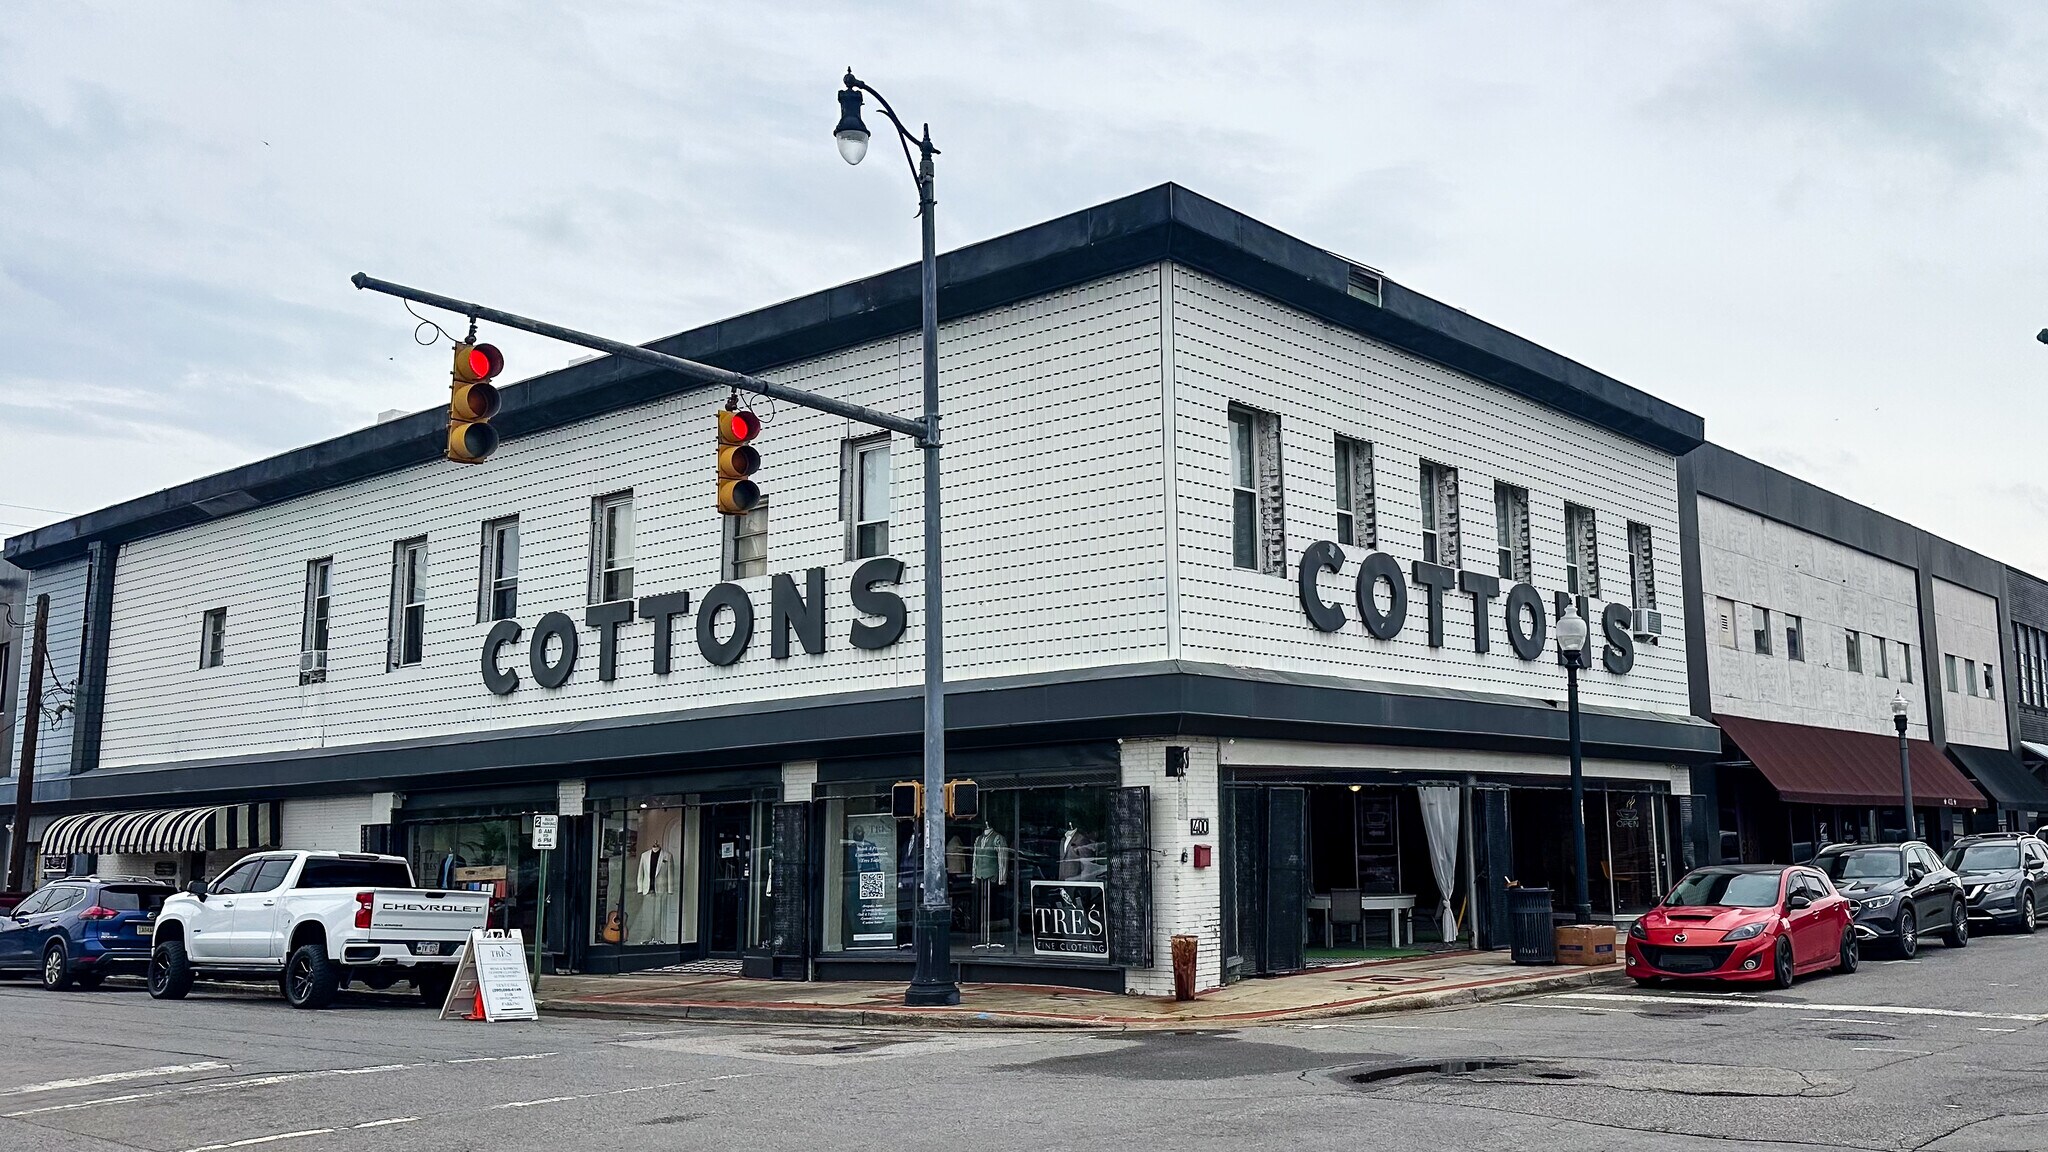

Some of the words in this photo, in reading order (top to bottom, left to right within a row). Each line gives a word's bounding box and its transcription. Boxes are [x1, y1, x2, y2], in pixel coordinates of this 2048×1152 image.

[481, 557, 908, 695] COTTONS
[535, 817, 541, 826] 2
[1191, 818, 1209, 835] 400
[1616, 820, 1639, 828] OPEN
[382, 903, 482, 913] CHEVROLET
[1037, 941, 1055, 951] FINE
[1060, 942, 1105, 953] CLOTHING
